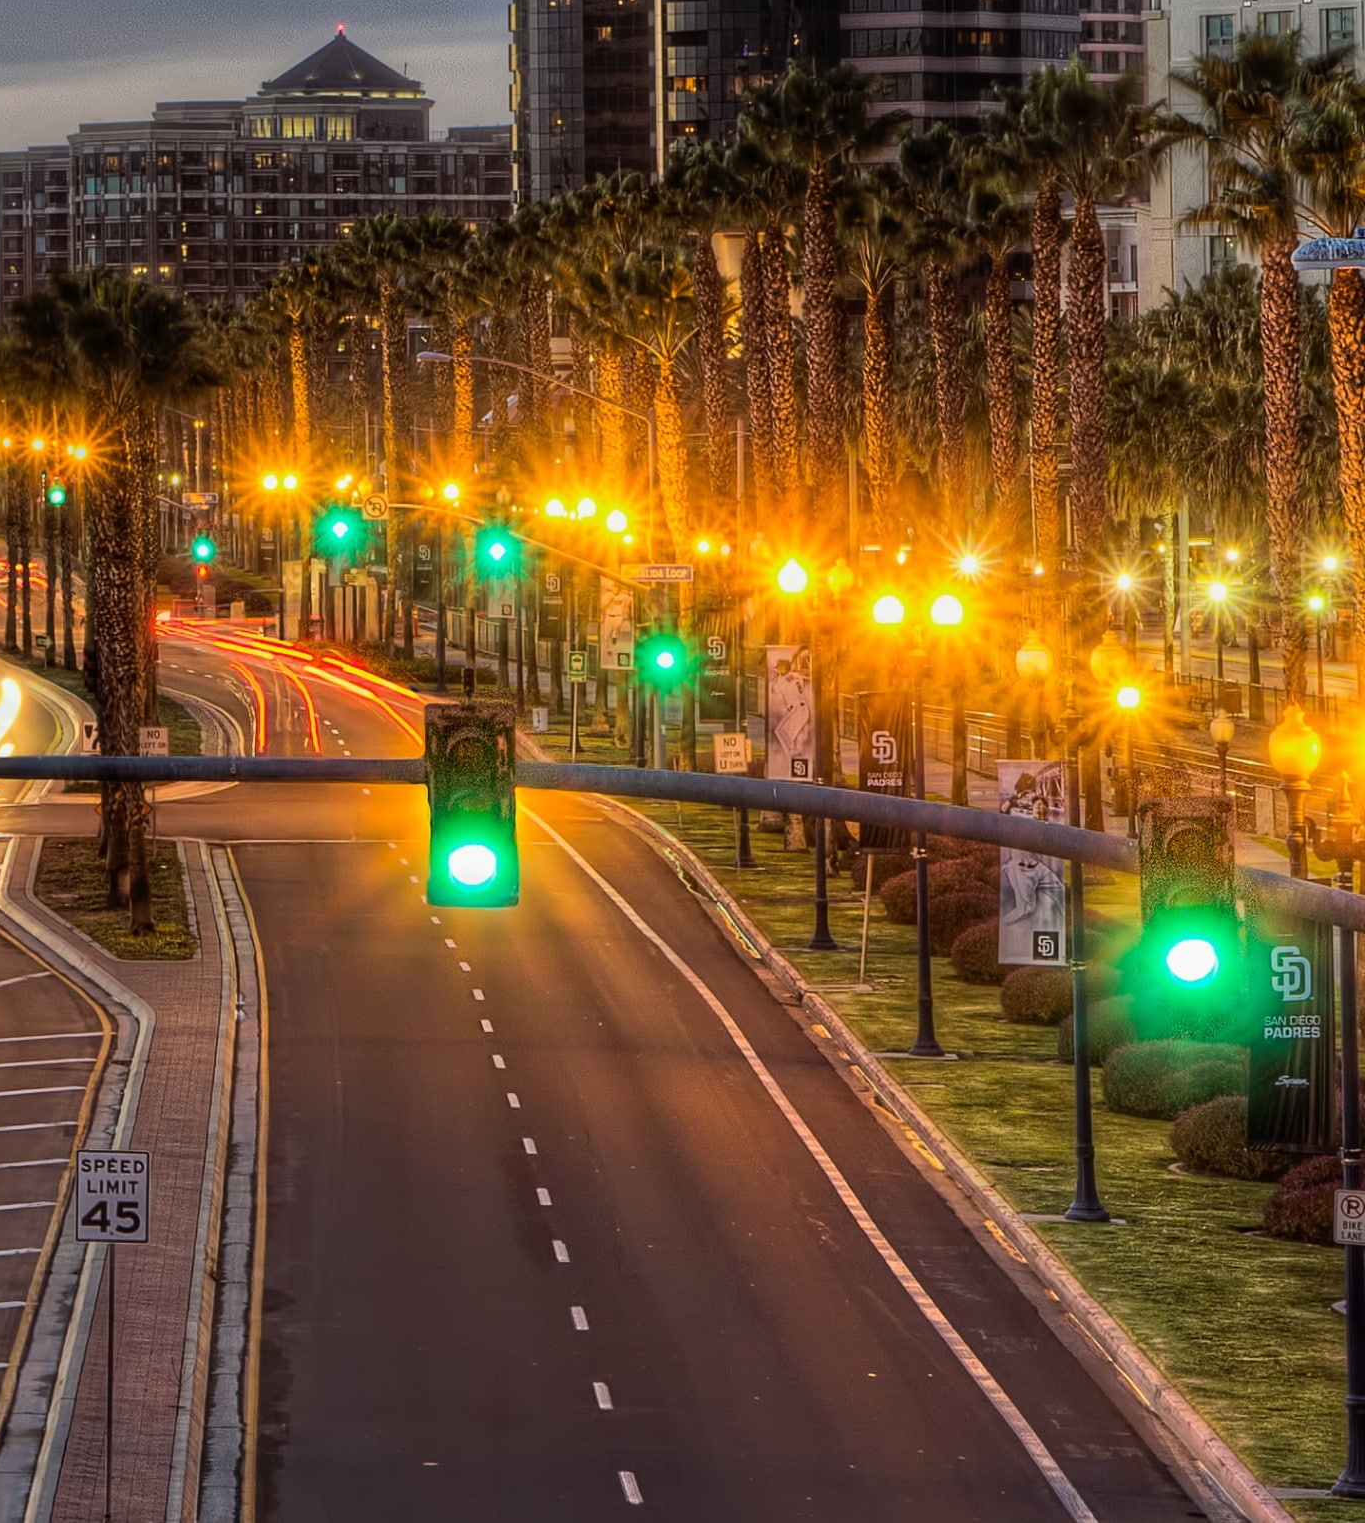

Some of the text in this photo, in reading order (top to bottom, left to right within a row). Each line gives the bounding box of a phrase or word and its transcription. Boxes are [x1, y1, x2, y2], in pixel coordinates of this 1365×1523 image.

[708, 636, 725, 659] SD
[147, 730, 160, 739] NO
[723, 737, 737, 747] NO
[871, 730, 897, 764] SD
[720, 760, 727, 769] U
[867, 778, 903, 787] PADRES
[1037, 935, 1055, 956] SD
[1270, 945, 1312, 1001] SD
[1264, 1015, 1321, 1027] SAN DIEGO
[1264, 1027, 1321, 1039] PADRES
[81, 1159, 144, 1174] SPEED
[87, 1180, 139, 1194] LIMIT
[81, 1200, 141, 1234] 45
[1342, 1220, 1363, 1231] BIKE
[1341, 1231, 1363, 1241] LANE
